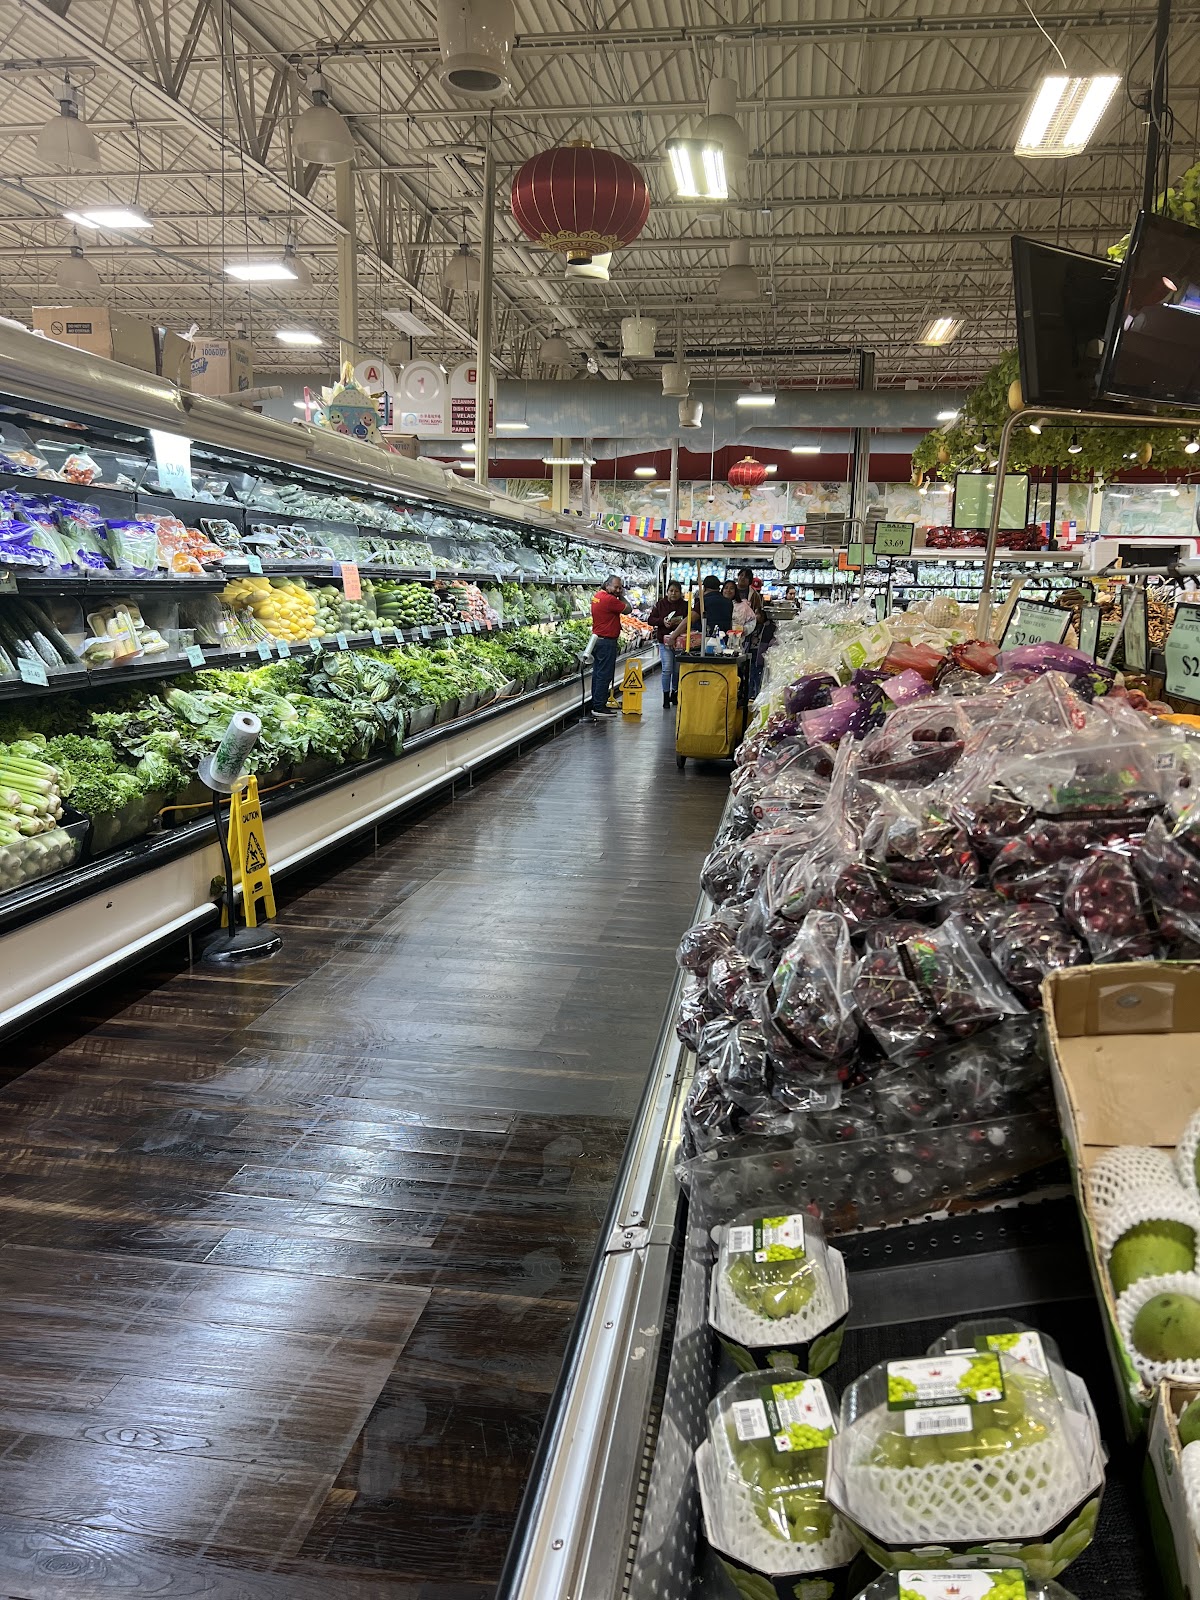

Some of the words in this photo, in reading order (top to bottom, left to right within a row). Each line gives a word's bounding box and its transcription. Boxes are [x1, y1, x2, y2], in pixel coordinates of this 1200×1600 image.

[367, 367, 378, 380] A
[417, 377, 425, 393] 1
[1026, 602, 1056, 614] SALE
[242, 810, 259, 823] CAUTION
